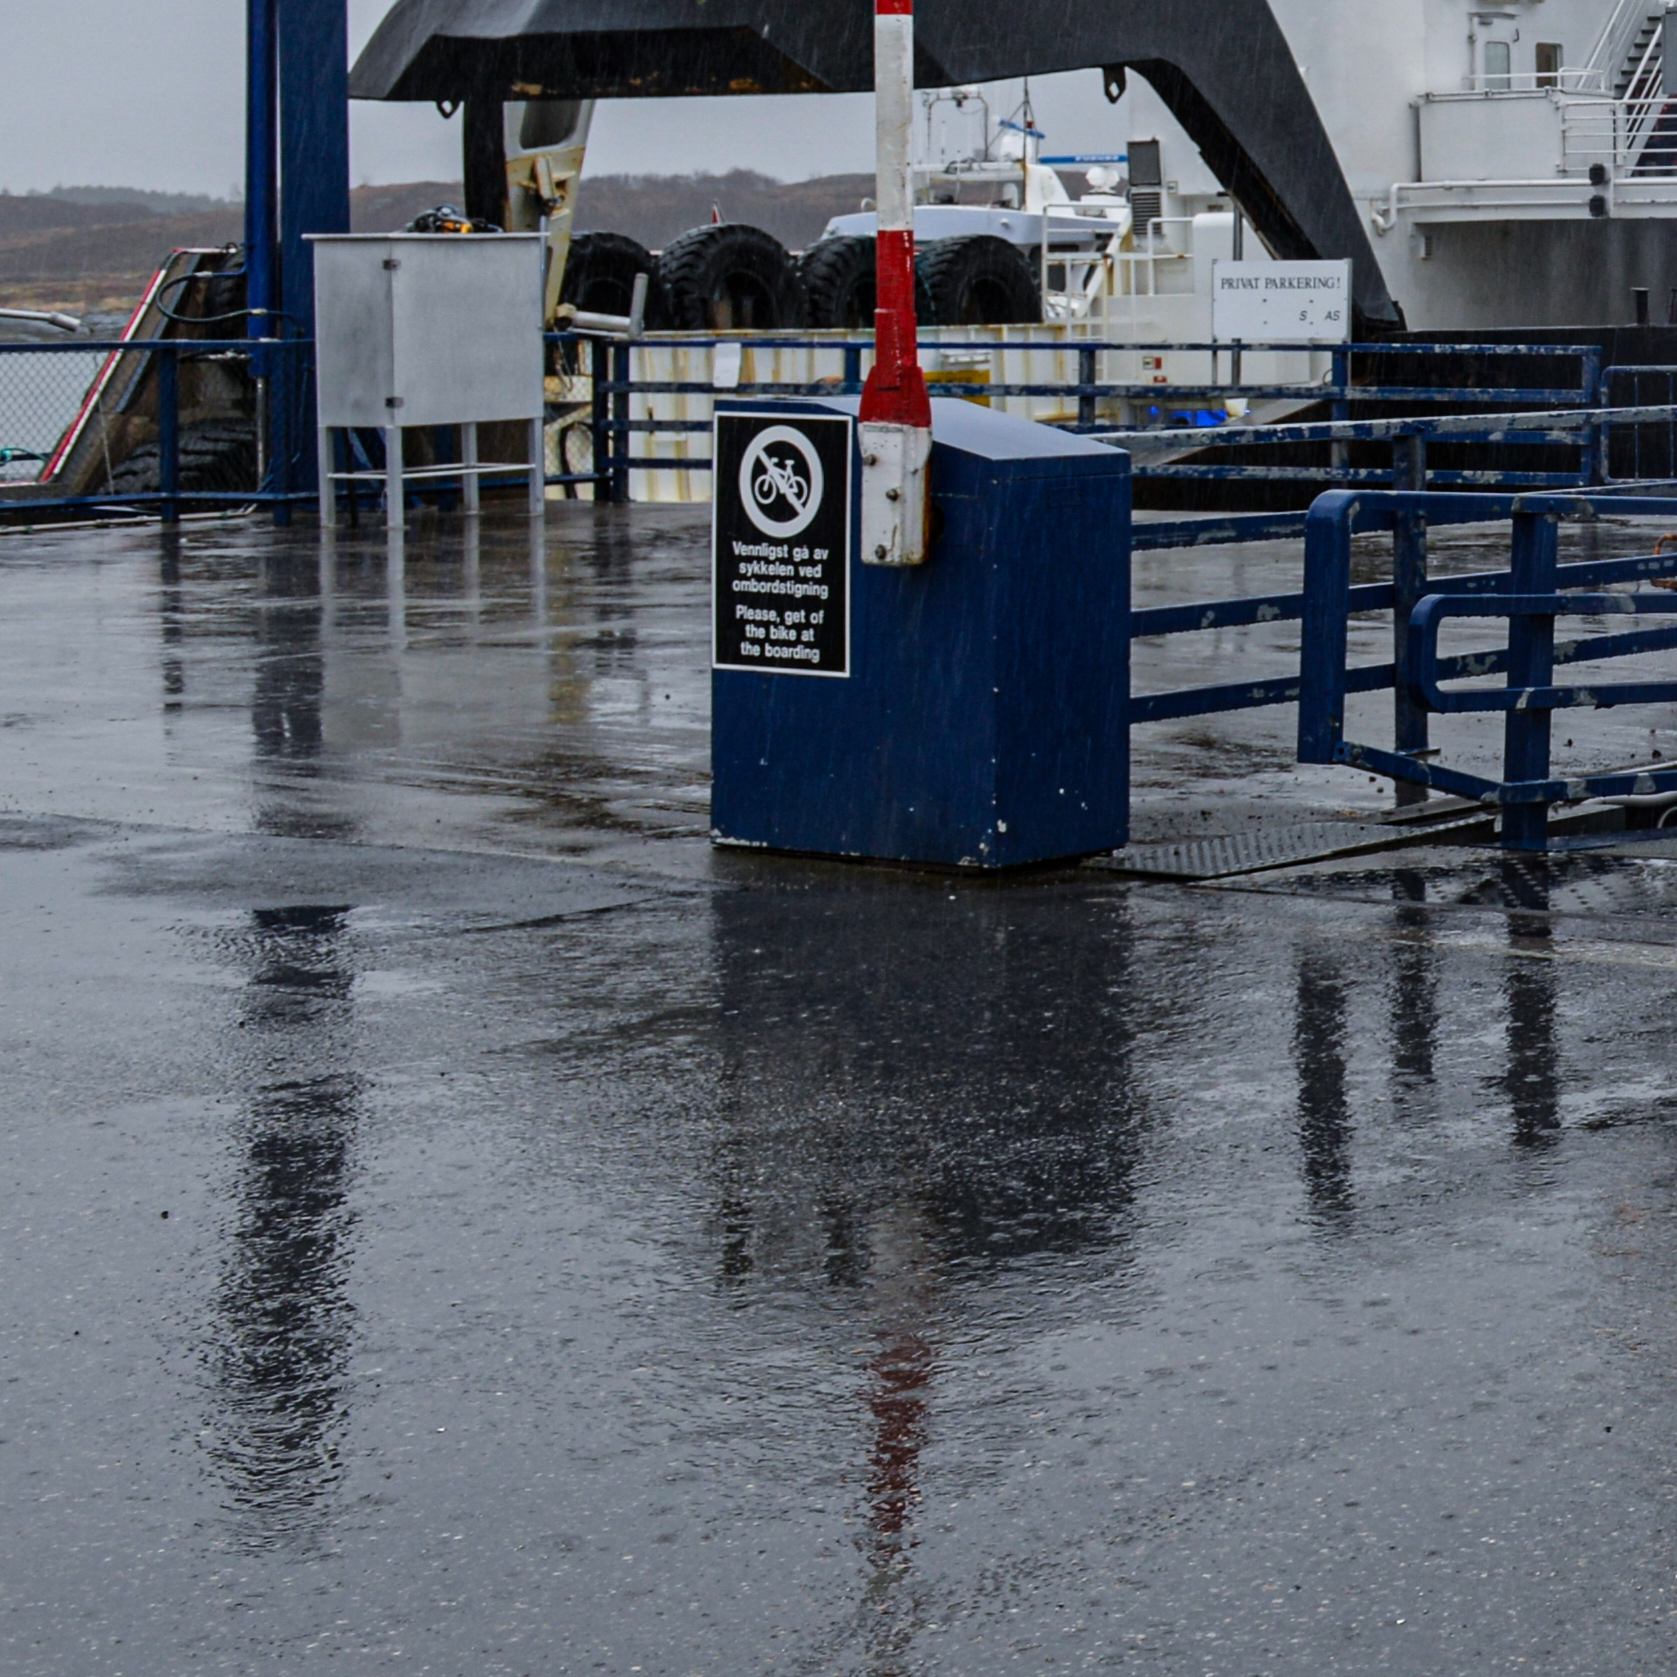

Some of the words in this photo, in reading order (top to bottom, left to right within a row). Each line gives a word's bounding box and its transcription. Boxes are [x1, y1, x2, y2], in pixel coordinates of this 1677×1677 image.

[1221, 277, 1261, 290] PRIVAT
[1265, 277, 1341, 290] PARKERING!
[1299, 310, 1308, 321] S
[1324, 310, 1341, 321] AS
[732, 540, 789, 561] Vennligst
[813, 548, 829, 560] av
[739, 560, 795, 577] sykkelen
[798, 563, 822, 578] ved
[732, 578, 829, 600] ombordstigning
[735, 604, 781, 624] Please,
[784, 609, 806, 626] get
[809, 609, 825, 624] of
[745, 624, 766, 639] the
[769, 625, 797, 641] bike
[801, 628, 815, 642] at
[740, 641, 761, 656] the
[764, 642, 820, 664] boarding
